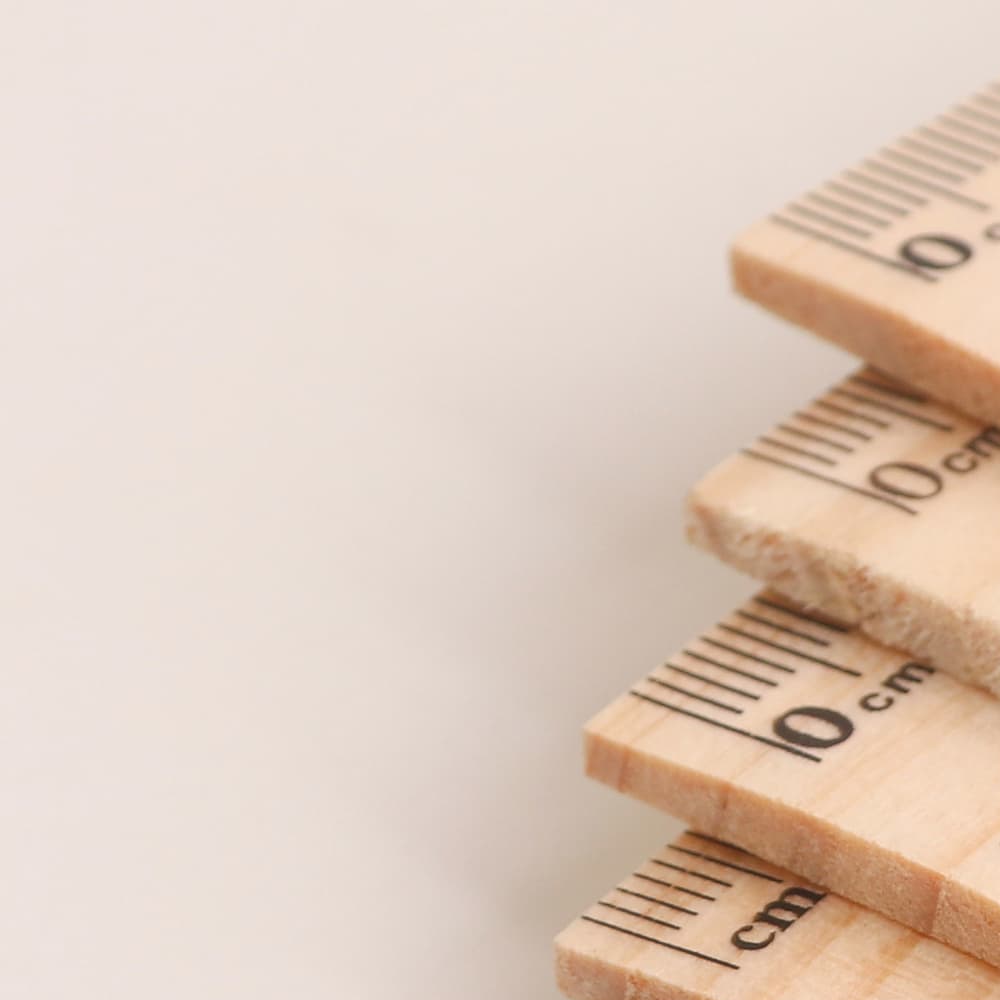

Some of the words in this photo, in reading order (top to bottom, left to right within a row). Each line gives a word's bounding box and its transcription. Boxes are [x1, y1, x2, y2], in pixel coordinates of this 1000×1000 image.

[900, 233, 973, 271] 0
[869, 462, 943, 500] 0
[773, 706, 854, 748] 0
[859, 662, 936, 712] cm
[731, 887, 828, 950] cm
